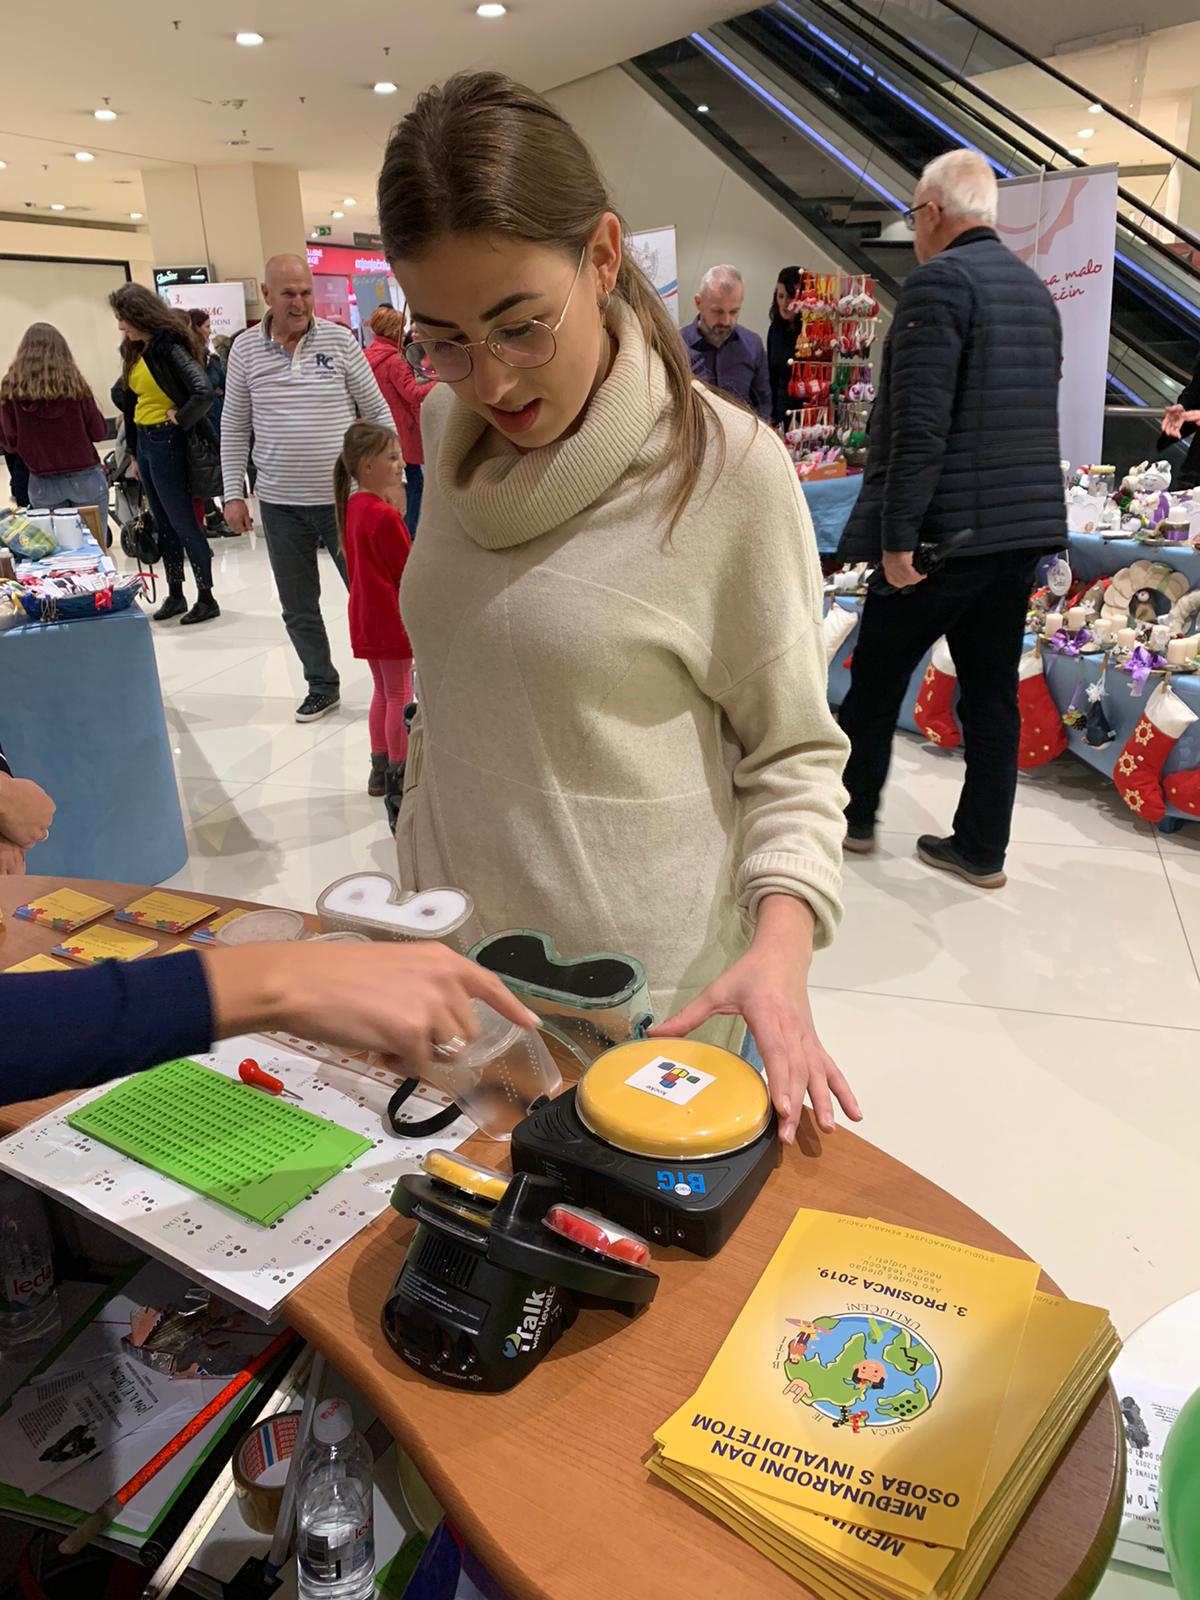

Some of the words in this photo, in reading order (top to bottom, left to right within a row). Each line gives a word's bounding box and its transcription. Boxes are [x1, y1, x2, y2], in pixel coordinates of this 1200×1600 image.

[1065, 258, 1103, 281] malo
[1051, 285, 1085, 301] ačin
[316, 353, 334, 370] RC
[816, 1267, 859, 1286] 2019.
[848, 1262, 884, 1279] gledao
[862, 1279, 948, 1312] PROSINCA
[922, 1283, 942, 1294] Ako
[953, 1304, 968, 1317] 3.
[532, 1326, 543, 1349] with
[691, 1413, 855, 1481] INVALIDITETOM
[710, 1439, 757, 1467] DAN
[858, 1470, 875, 1485] S
[1135, 1469, 1158, 1481] ATIVNE
[759, 1457, 928, 1521] MEĐUNARODNI
[881, 1473, 960, 1508] OSOBA
[1137, 1494, 1149, 1509] TO
